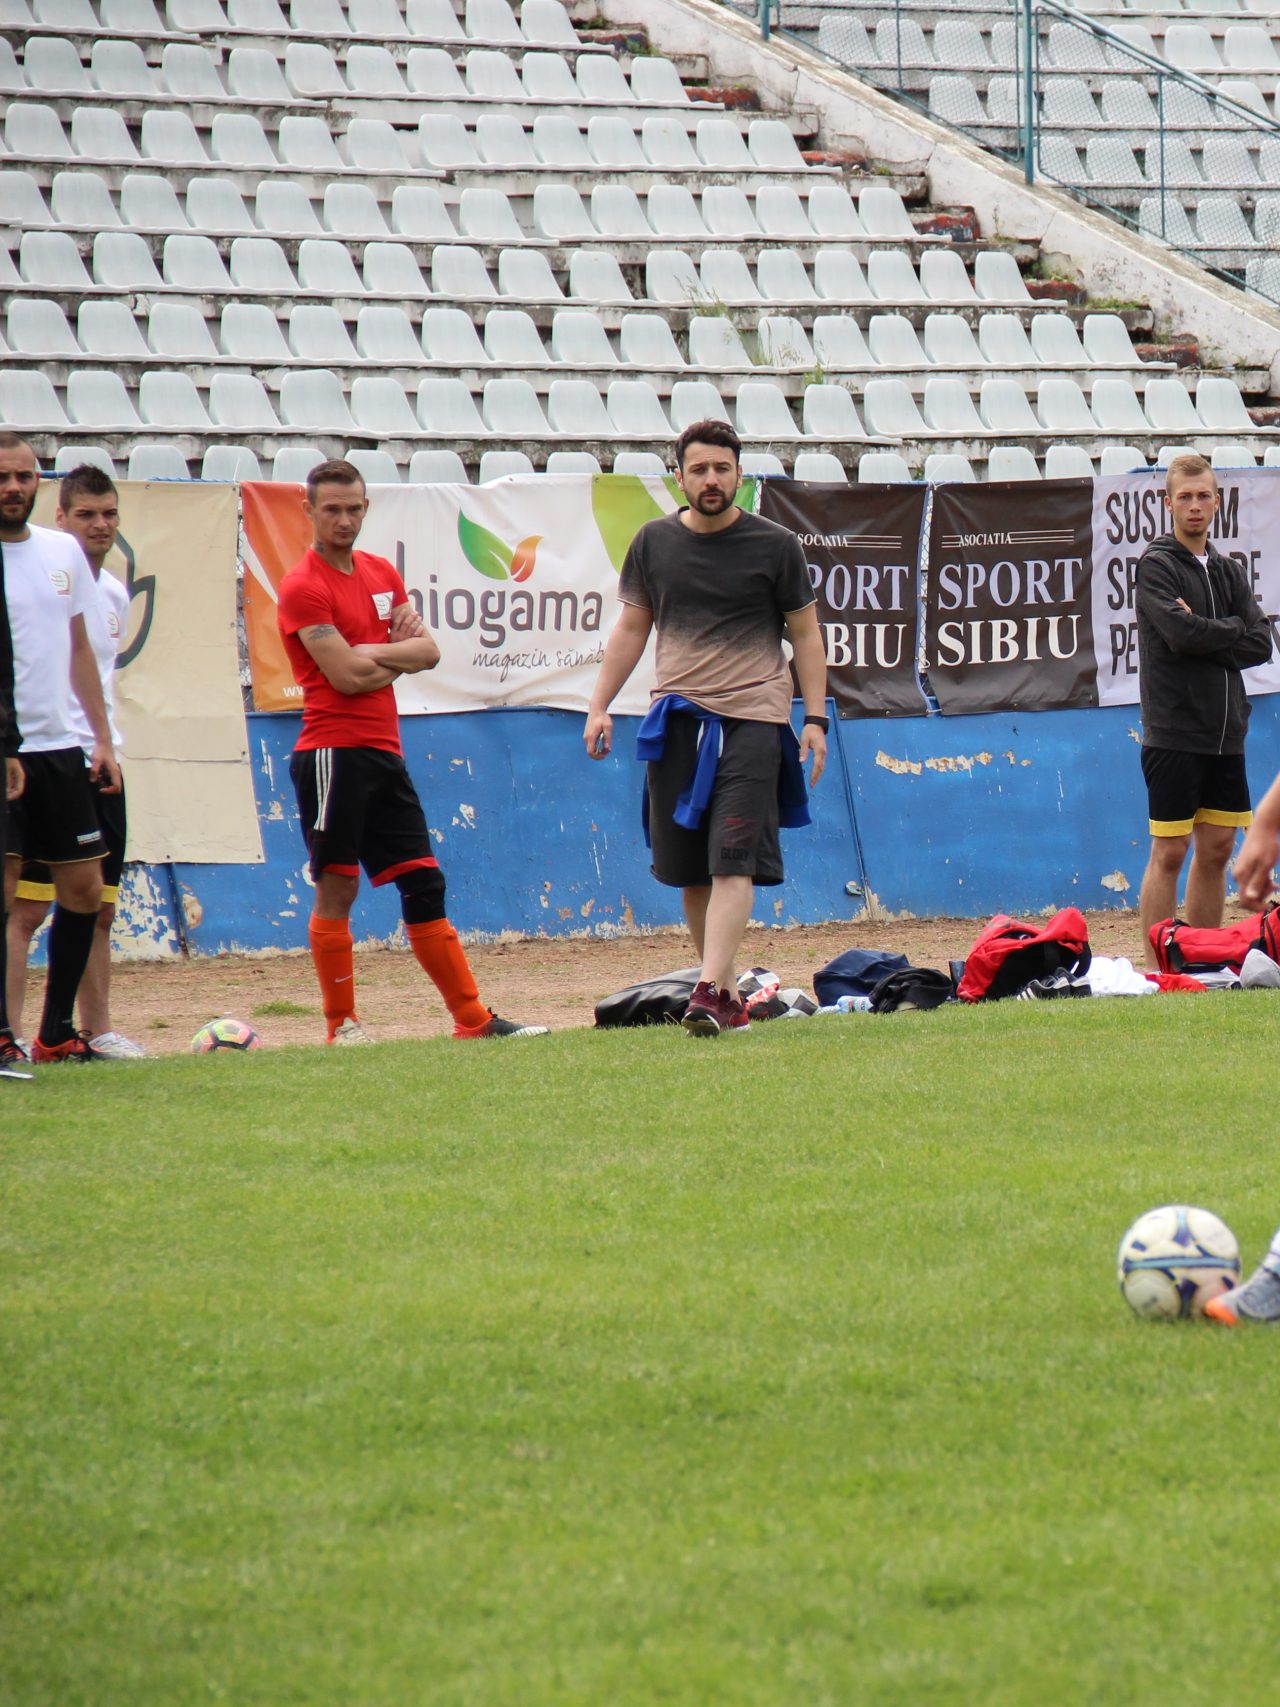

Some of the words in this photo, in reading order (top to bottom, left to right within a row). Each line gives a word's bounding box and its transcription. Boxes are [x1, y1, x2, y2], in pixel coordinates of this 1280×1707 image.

[797, 533, 849, 547] SOCIATIA
[958, 532, 1013, 547] ASOCIATIA
[937, 557, 1083, 611] SPORT
[937, 614, 1082, 667] SIBIU
[472, 647, 551, 683] magazin
